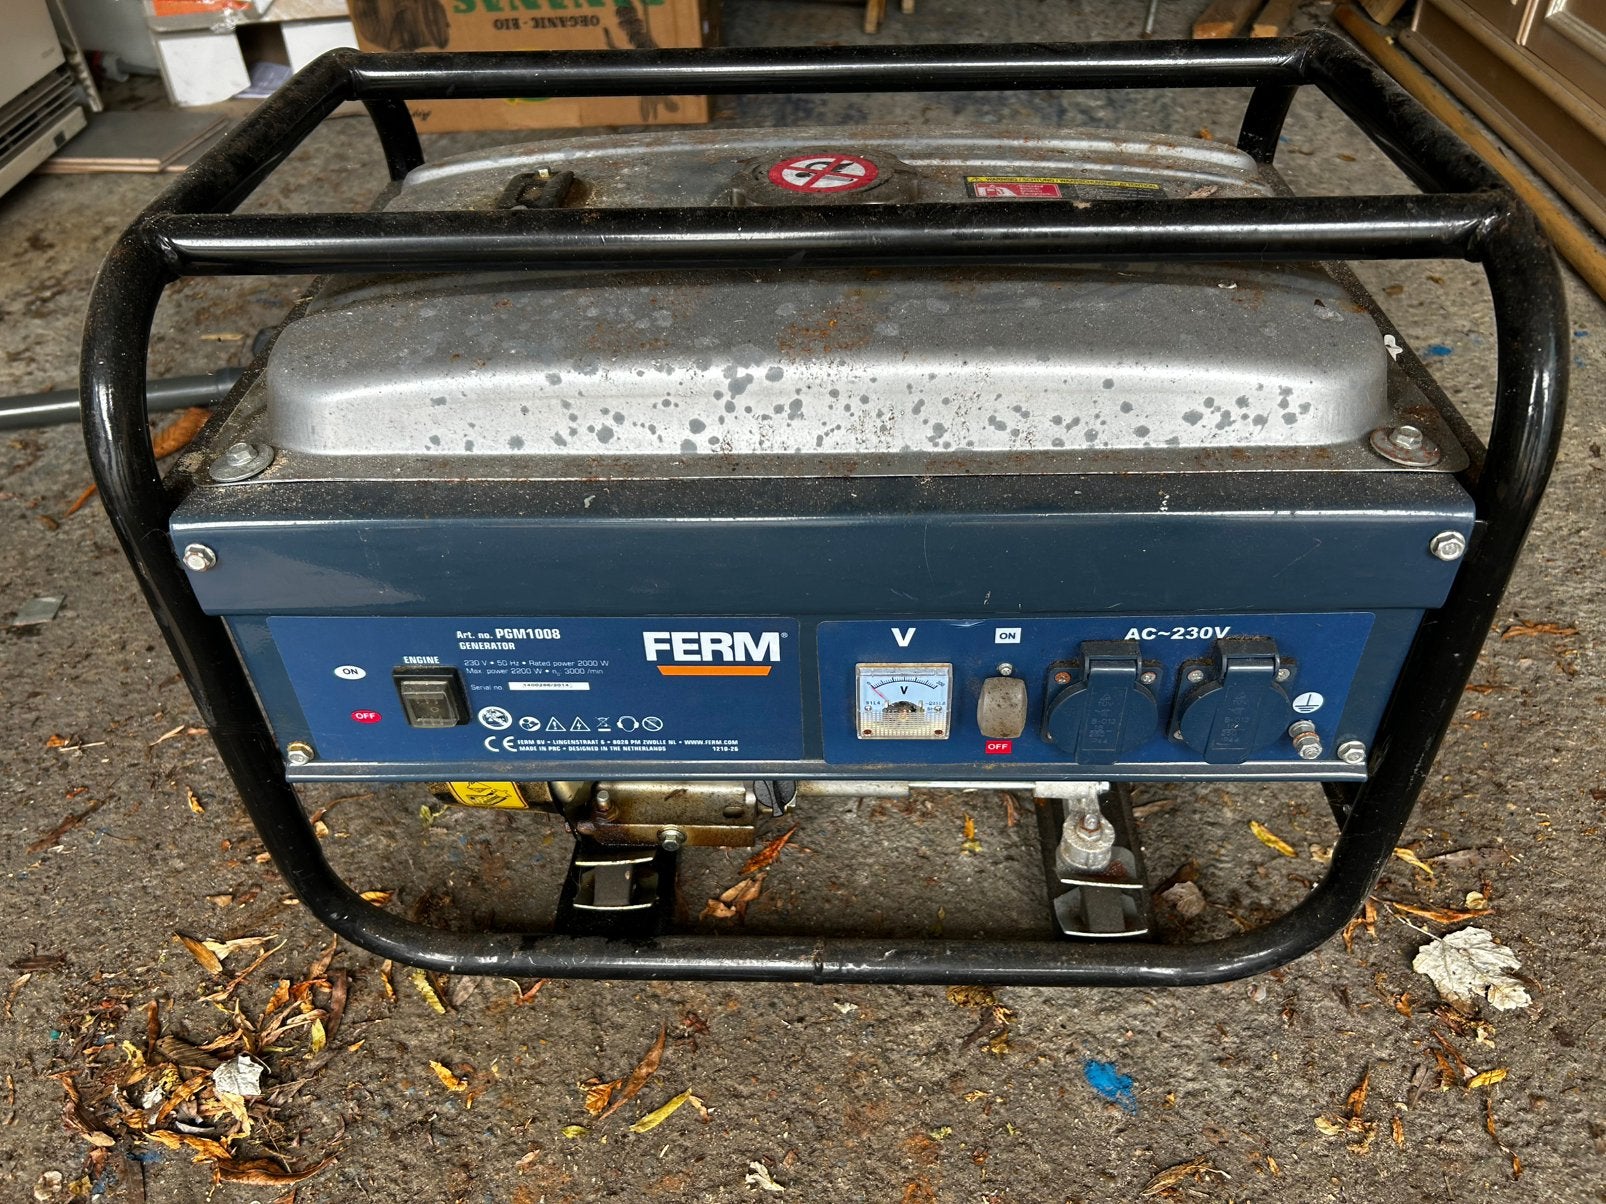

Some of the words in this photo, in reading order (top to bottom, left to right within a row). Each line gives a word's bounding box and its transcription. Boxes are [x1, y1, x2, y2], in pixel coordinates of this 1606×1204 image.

[493, 17, 521, 31] BIO
[531, 15, 600, 29] ORGANIC
[456, 631, 476, 639] Art.
[495, 628, 561, 640] PGM1008
[891, 627, 916, 647] V
[999, 632, 1016, 640] ON
[459, 641, 516, 650] GENERATOR
[642, 631, 781, 662] FERM
[403, 656, 440, 664] ENGINE
[463, 659, 480, 667] 230
[496, 659, 508, 667] 50
[510, 667, 532, 675] 2200
[900, 685, 908, 695] V
[355, 712, 376, 720] OFF
